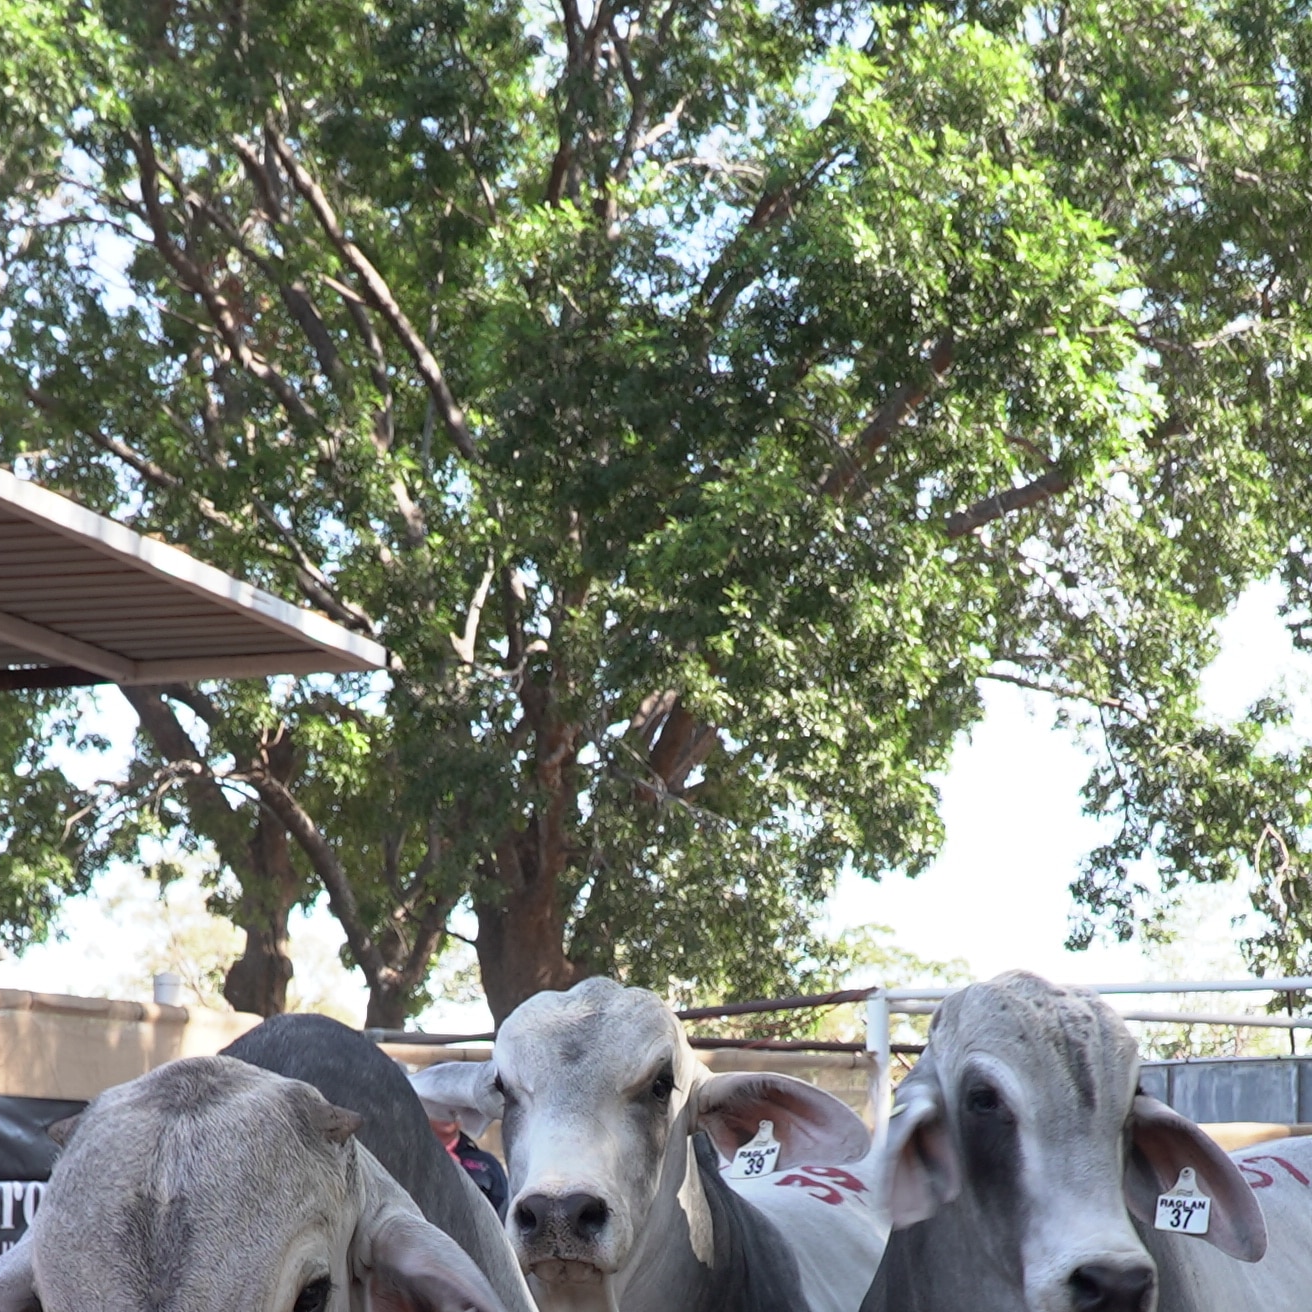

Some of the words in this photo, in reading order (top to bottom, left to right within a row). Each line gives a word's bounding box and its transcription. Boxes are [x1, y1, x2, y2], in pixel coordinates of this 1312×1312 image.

[738, 1146, 777, 1159] RAGLAN
[744, 1156, 765, 1175] 39
[1160, 1198, 1206, 1211] RAGLAN
[1170, 1208, 1194, 1229] 37
